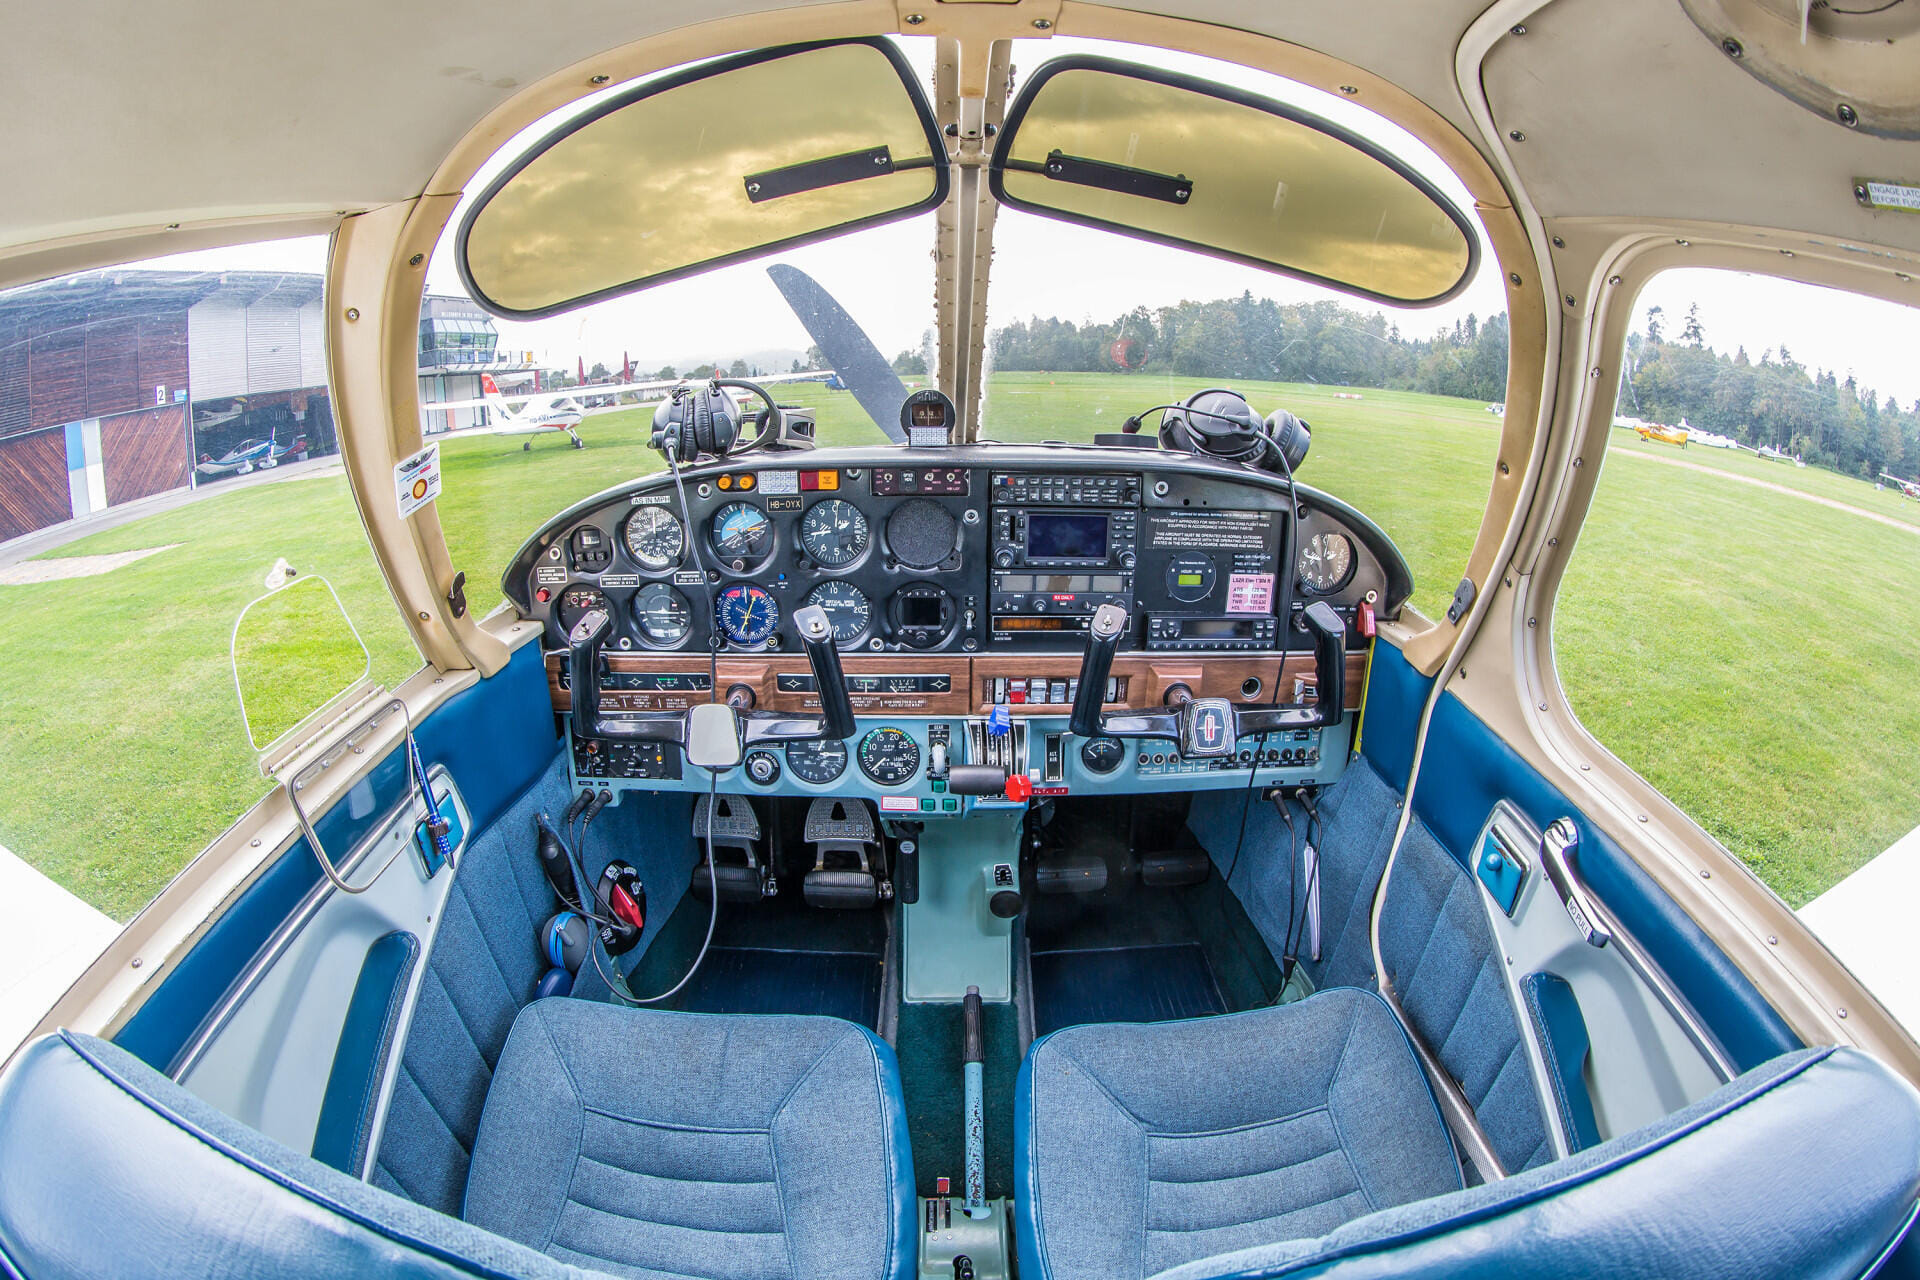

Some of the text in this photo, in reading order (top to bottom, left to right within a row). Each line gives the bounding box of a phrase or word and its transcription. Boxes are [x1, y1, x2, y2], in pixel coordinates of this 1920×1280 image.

[1870, 184, 1900, 195] ENGAGE
[1872, 195, 1900, 204] BEFORE
[158, 390, 164, 401] 2
[816, 824, 864, 832] PIPER
[1568, 901, 1588, 934] NO PULL
